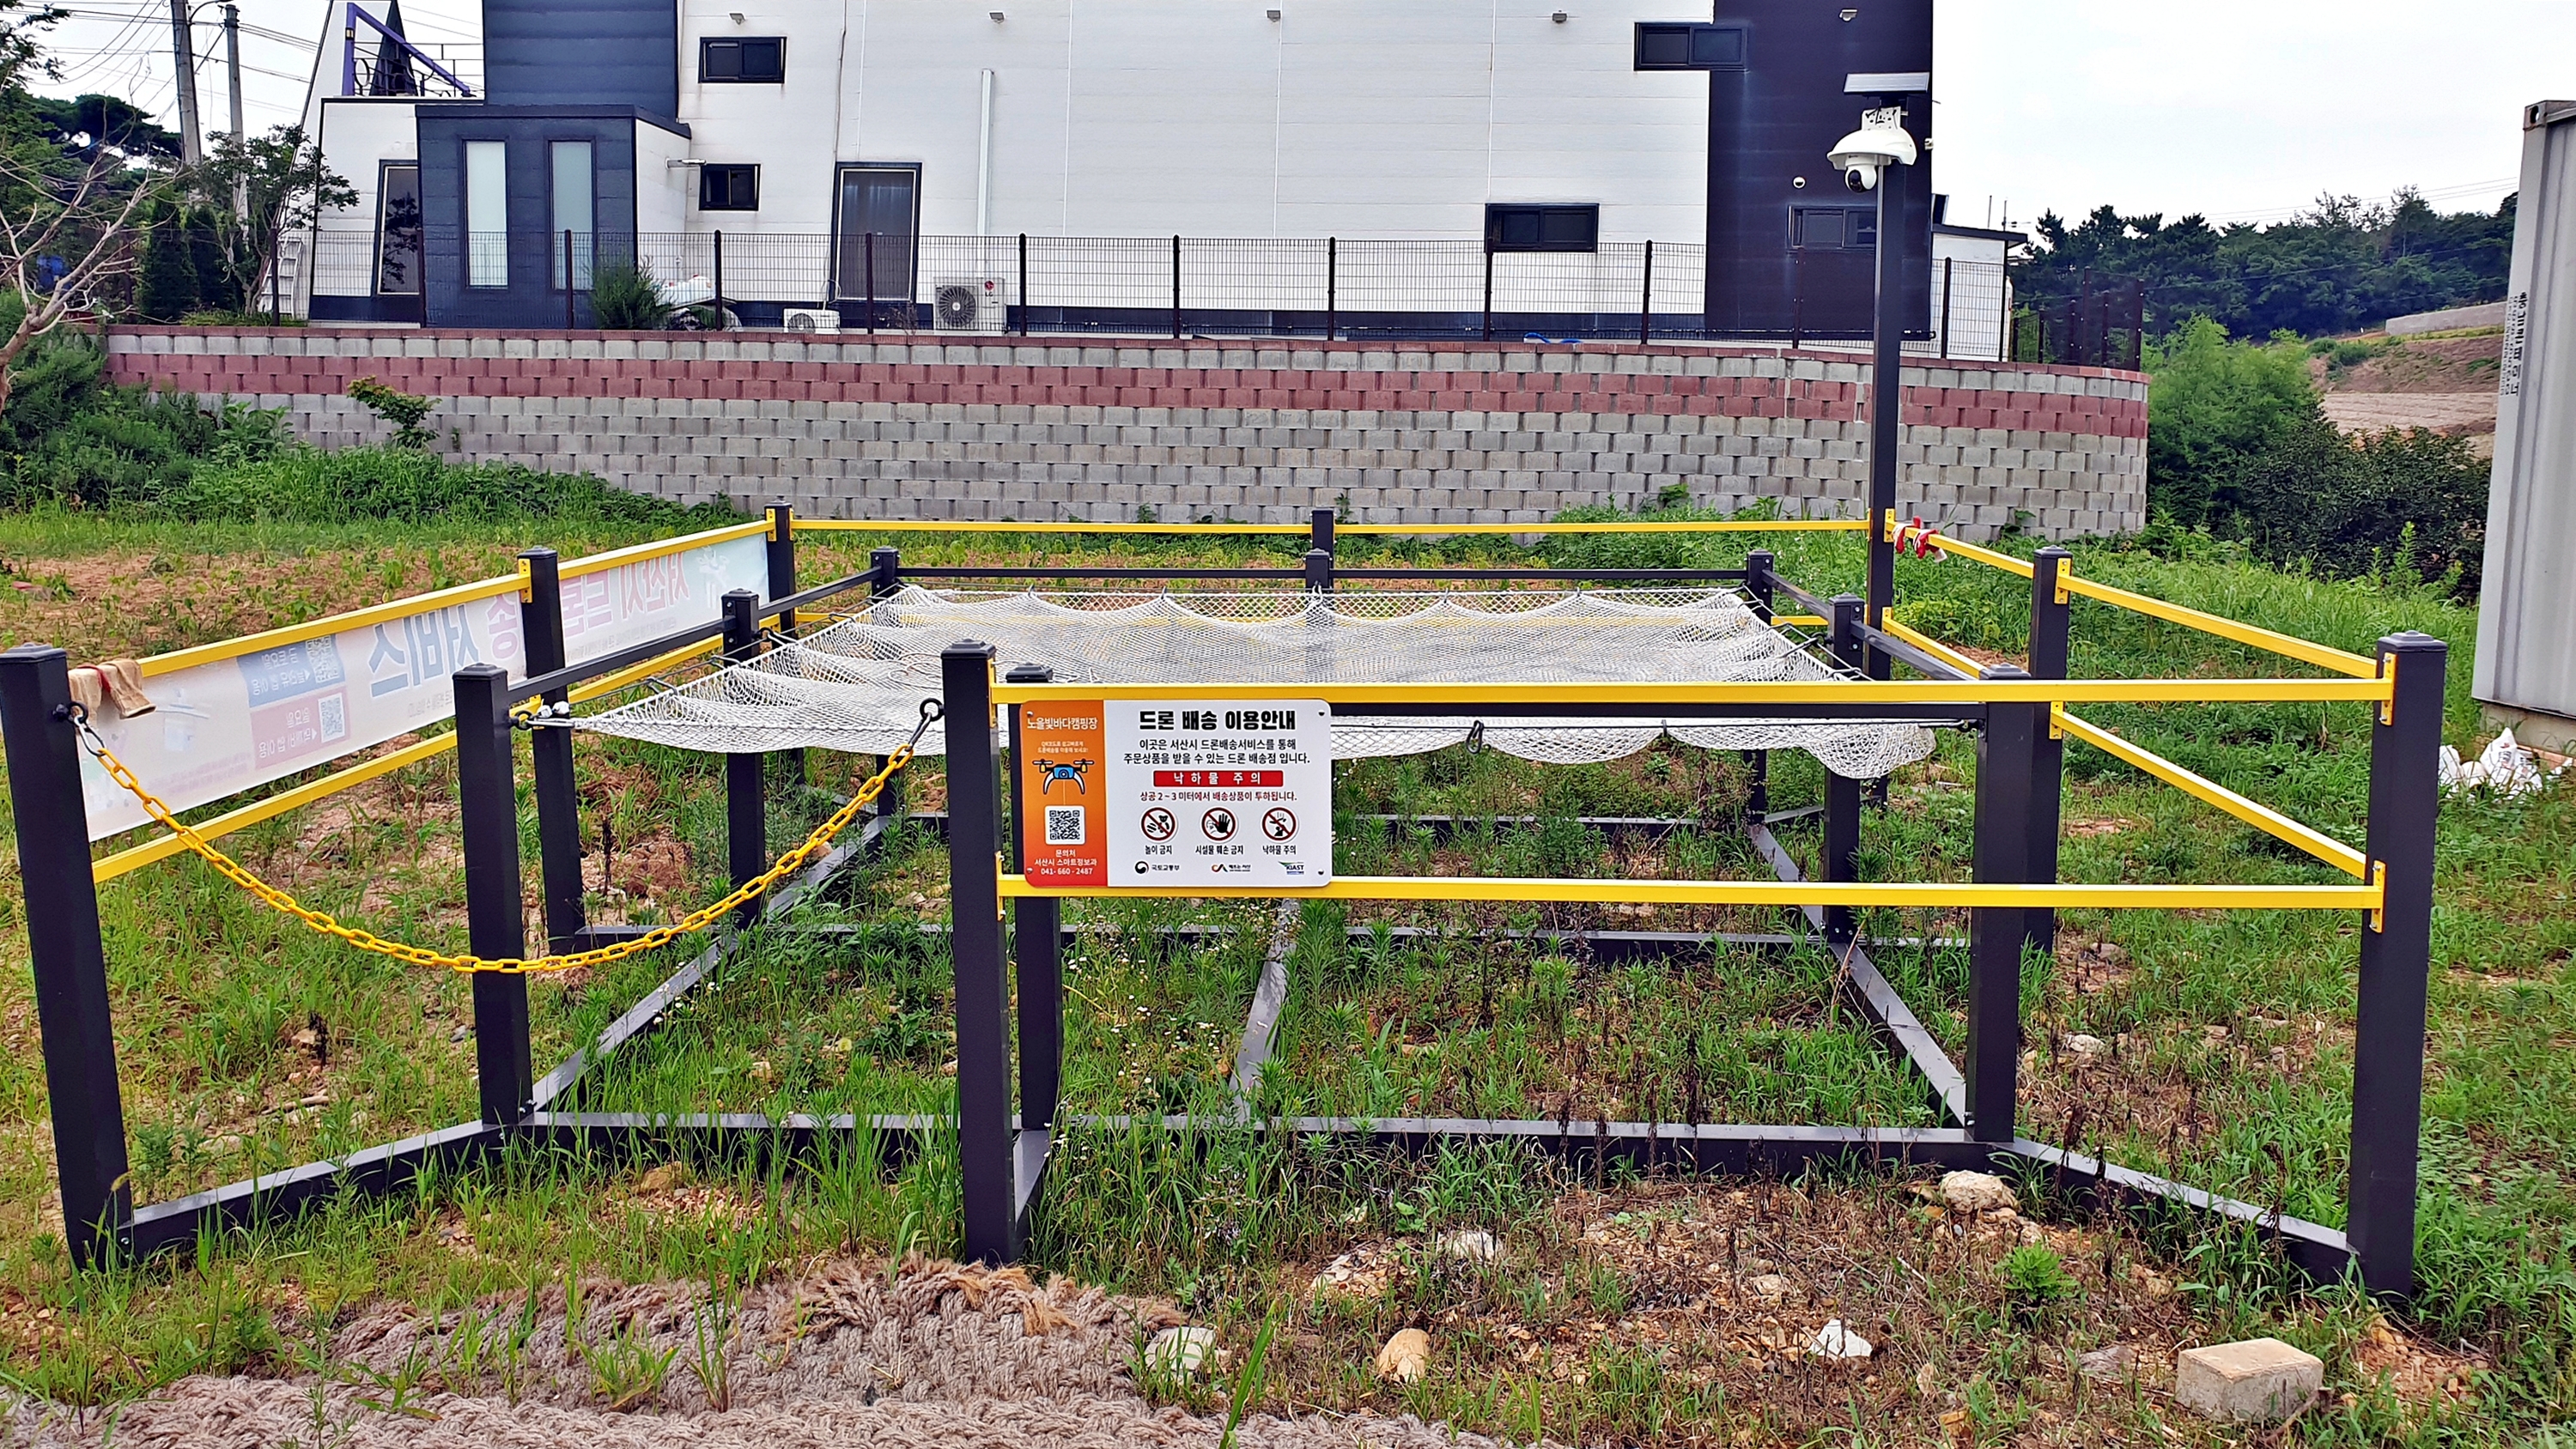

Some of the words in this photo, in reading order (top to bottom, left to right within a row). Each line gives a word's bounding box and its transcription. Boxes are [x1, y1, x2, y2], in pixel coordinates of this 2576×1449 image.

[1027, 717, 1098, 730] 노을빛바다캠핑장
[1139, 710, 1175, 730] 드론
[1182, 710, 1218, 730] 배송
[1224, 710, 1296, 730] 이용안내
[1139, 739, 1167, 750] 이곳은
[1170, 739, 1198, 750] 서산시
[1200, 739, 1274, 750] 드론배송서비스를
[1278, 739, 1297, 750] 통해
[1123, 753, 1170, 764] 주문상품을
[1173, 753, 1192, 764] 받을
[1194, 753, 1203, 764] 수
[1206, 753, 1224, 764] 있는
[1227, 753, 1245, 764] 드론
[1249, 753, 1276, 764] 배송점
[1279, 753, 1310, 764] 입니다.
[1140, 791, 1156, 802] 상공
[1158, 792, 1163, 801] 2
[1171, 792, 1177, 801] 3
[1179, 791, 1210, 802] 미터에서
[1212, 791, 1253, 802] 배송상품이
[1255, 791, 1298, 802] 투하됩니다.
[1055, 849, 1076, 858] 문의처
[1145, 845, 1157, 855] 놀이
[1159, 845, 1172, 855] 금지
[1195, 845, 1214, 855] 시설물
[1216, 845, 1230, 855] 훼손
[1230, 845, 1243, 855] 금지
[1262, 845, 1282, 855] 낙하물
[1283, 845, 1297, 855] 주의
